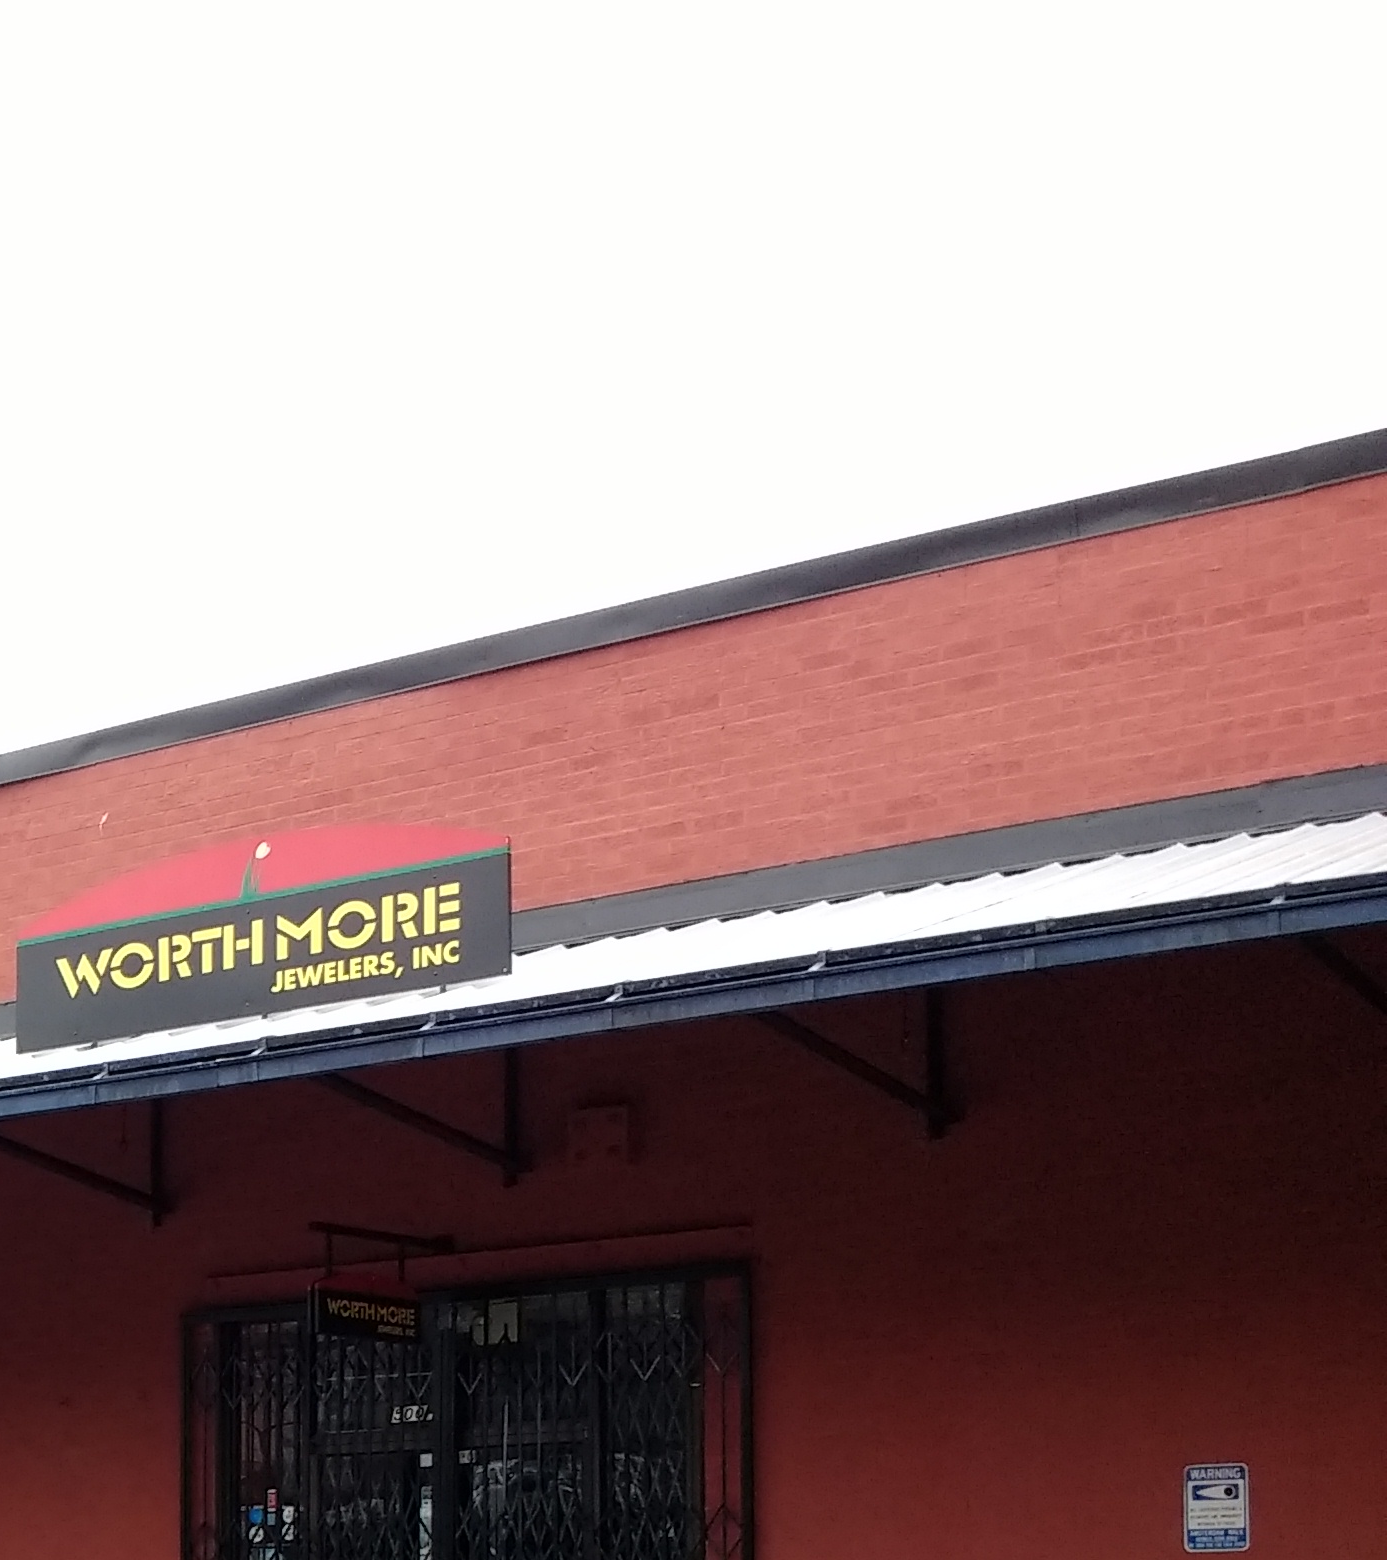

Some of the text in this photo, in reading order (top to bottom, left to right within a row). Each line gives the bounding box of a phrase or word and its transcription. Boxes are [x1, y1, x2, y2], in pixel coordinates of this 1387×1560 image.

[271, 940, 461, 993] JEWELERS, INC
[1190, 1467, 1241, 1480] WARNING
